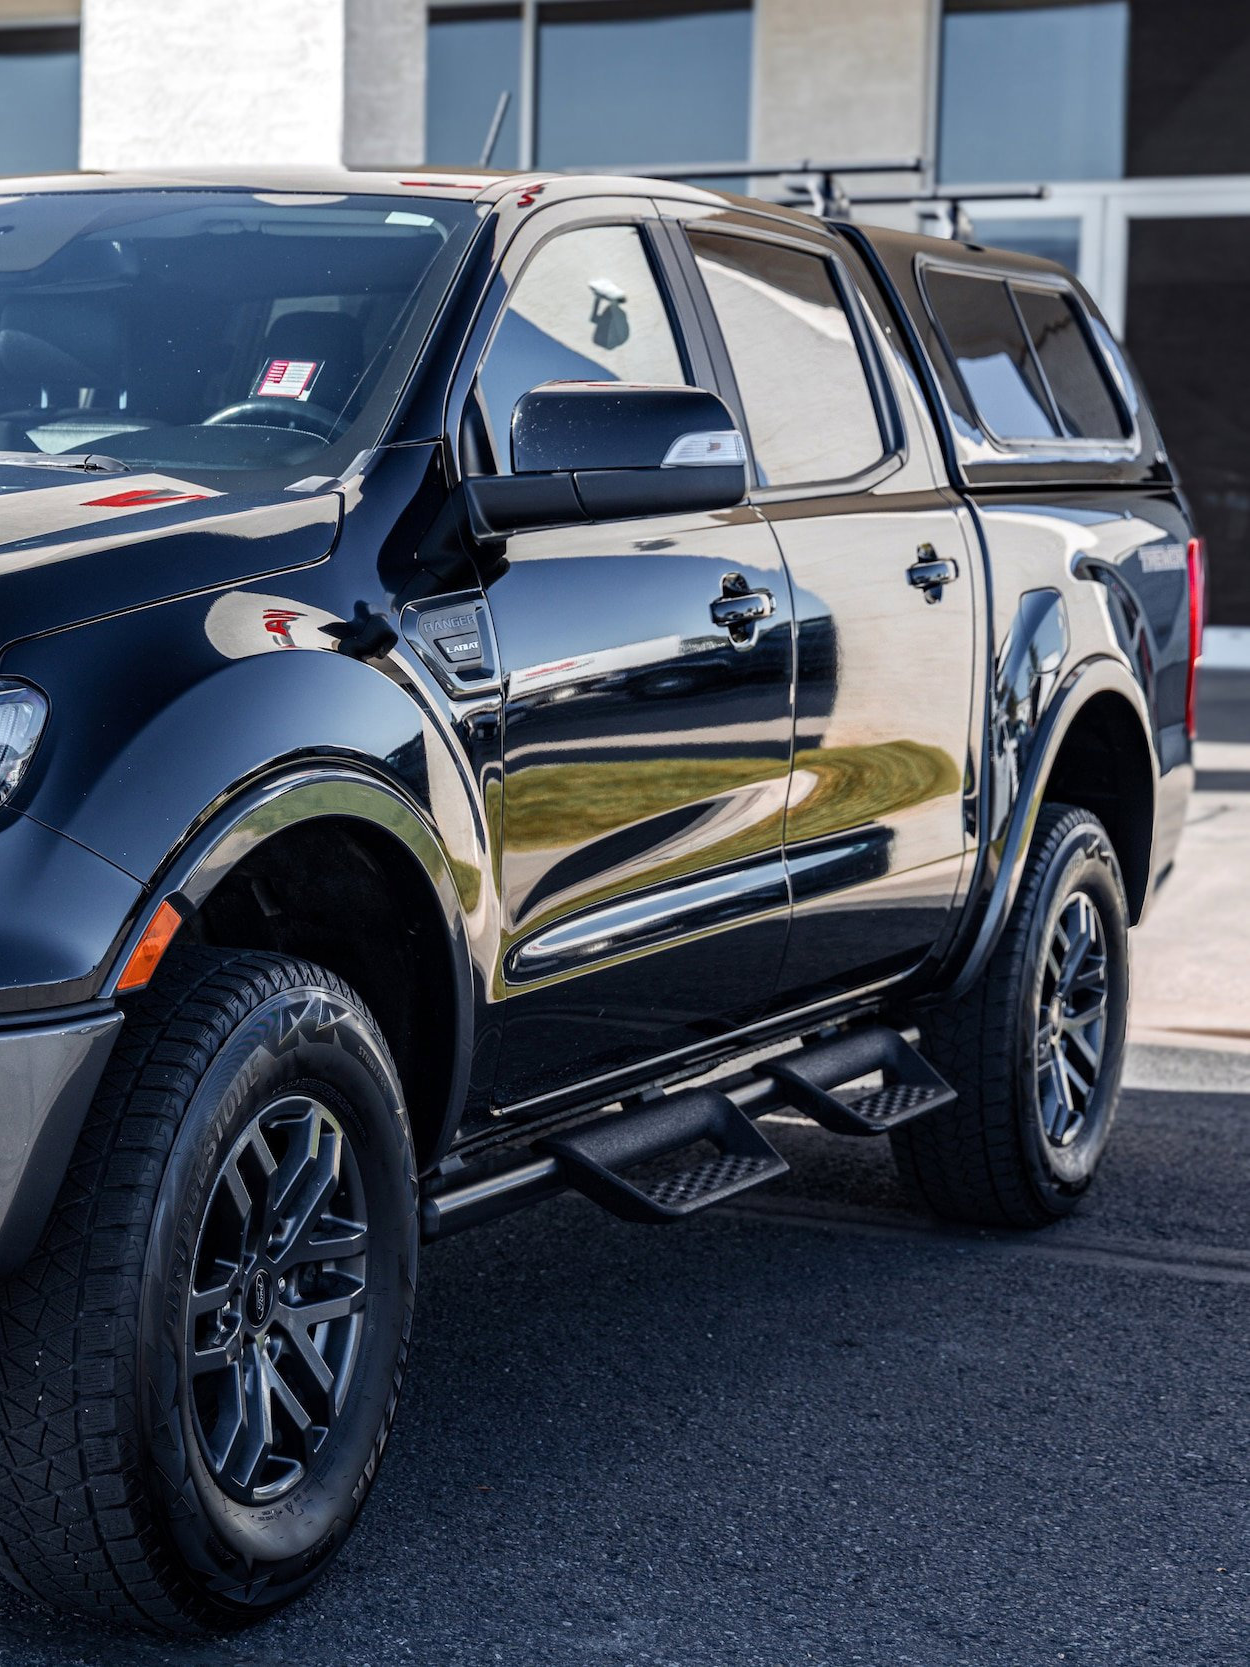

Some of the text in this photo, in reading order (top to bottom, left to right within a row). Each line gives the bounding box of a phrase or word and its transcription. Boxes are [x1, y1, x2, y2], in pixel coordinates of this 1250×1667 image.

[423, 614, 477, 633] RANGER
[446, 641, 479, 654] LARIAT
[164, 1050, 261, 1329] BRIDGESTONE
